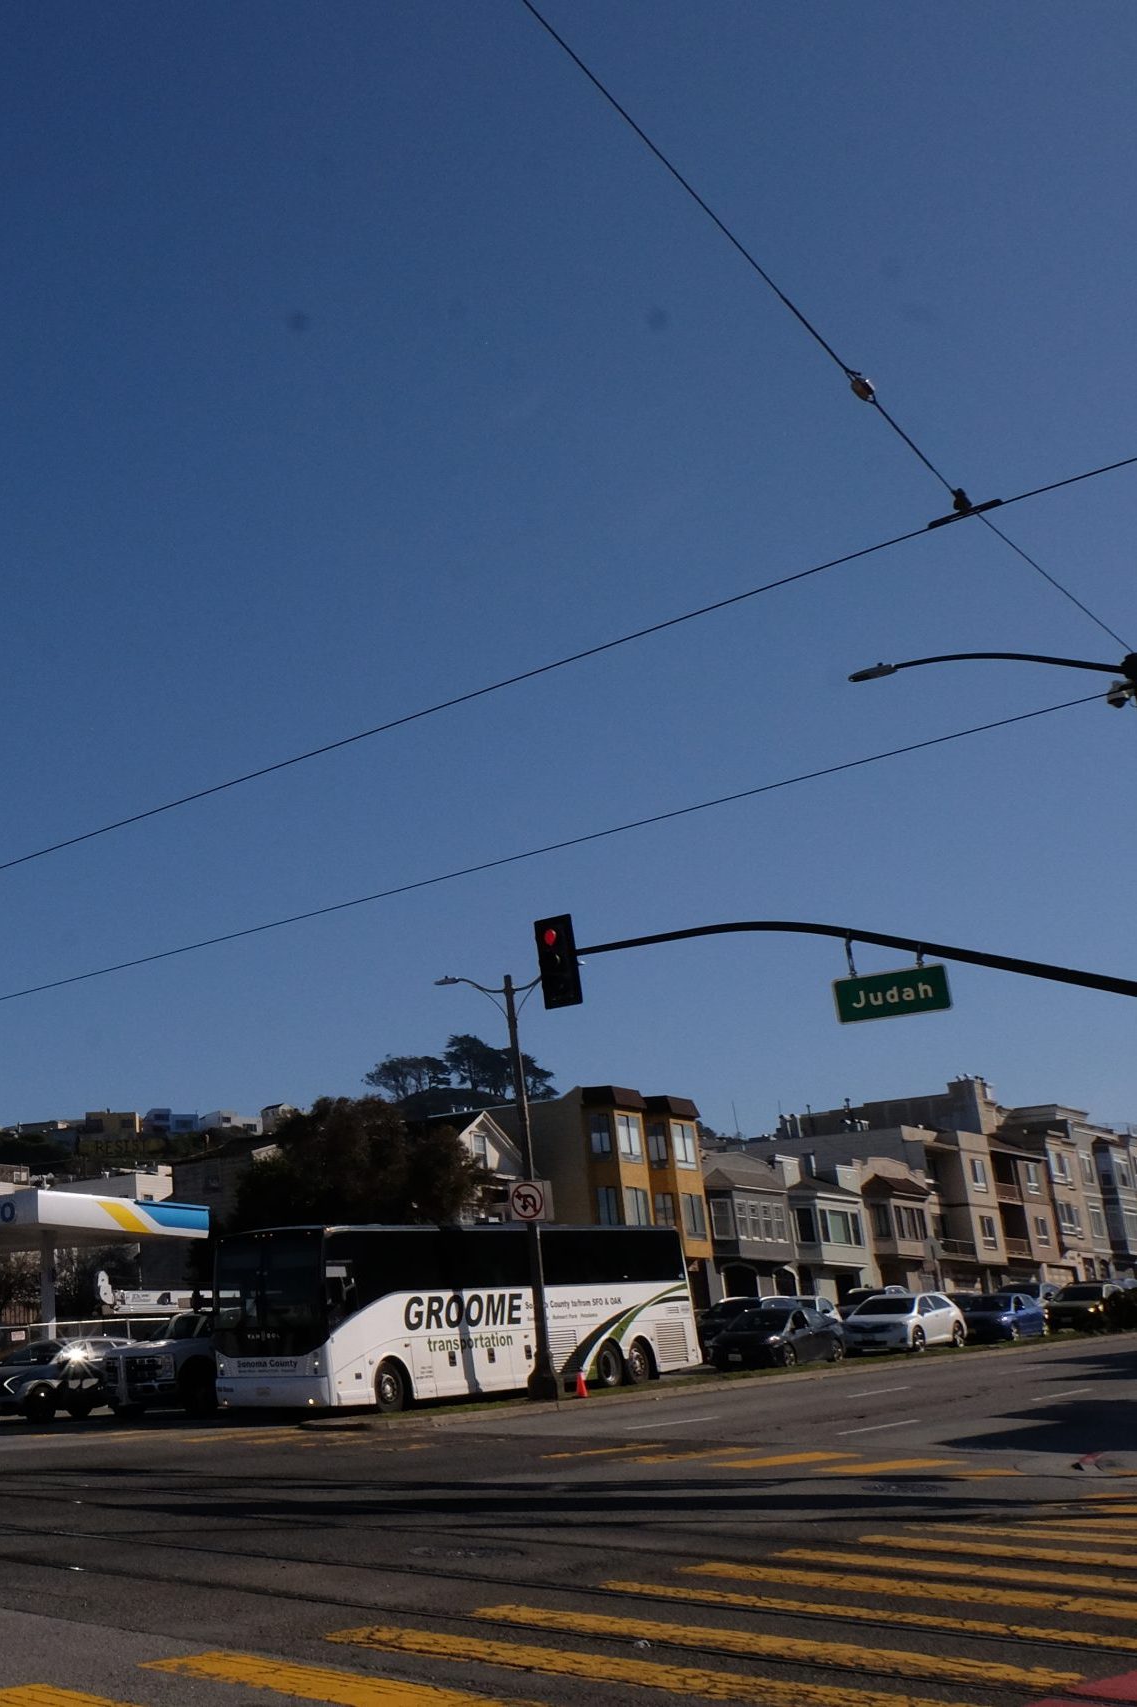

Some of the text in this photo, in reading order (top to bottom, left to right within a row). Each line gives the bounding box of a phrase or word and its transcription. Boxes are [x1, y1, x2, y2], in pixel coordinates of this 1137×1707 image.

[851, 982, 934, 1009] Judah
[404, 1293, 523, 1331] GROOME
[550, 1300, 571, 1310] County
[592, 1297, 603, 1306] SFO
[610, 1296, 623, 1305] OAK
[427, 1332, 514, 1353] transportation
[237, 1359, 298, 1369] Sonoma County
